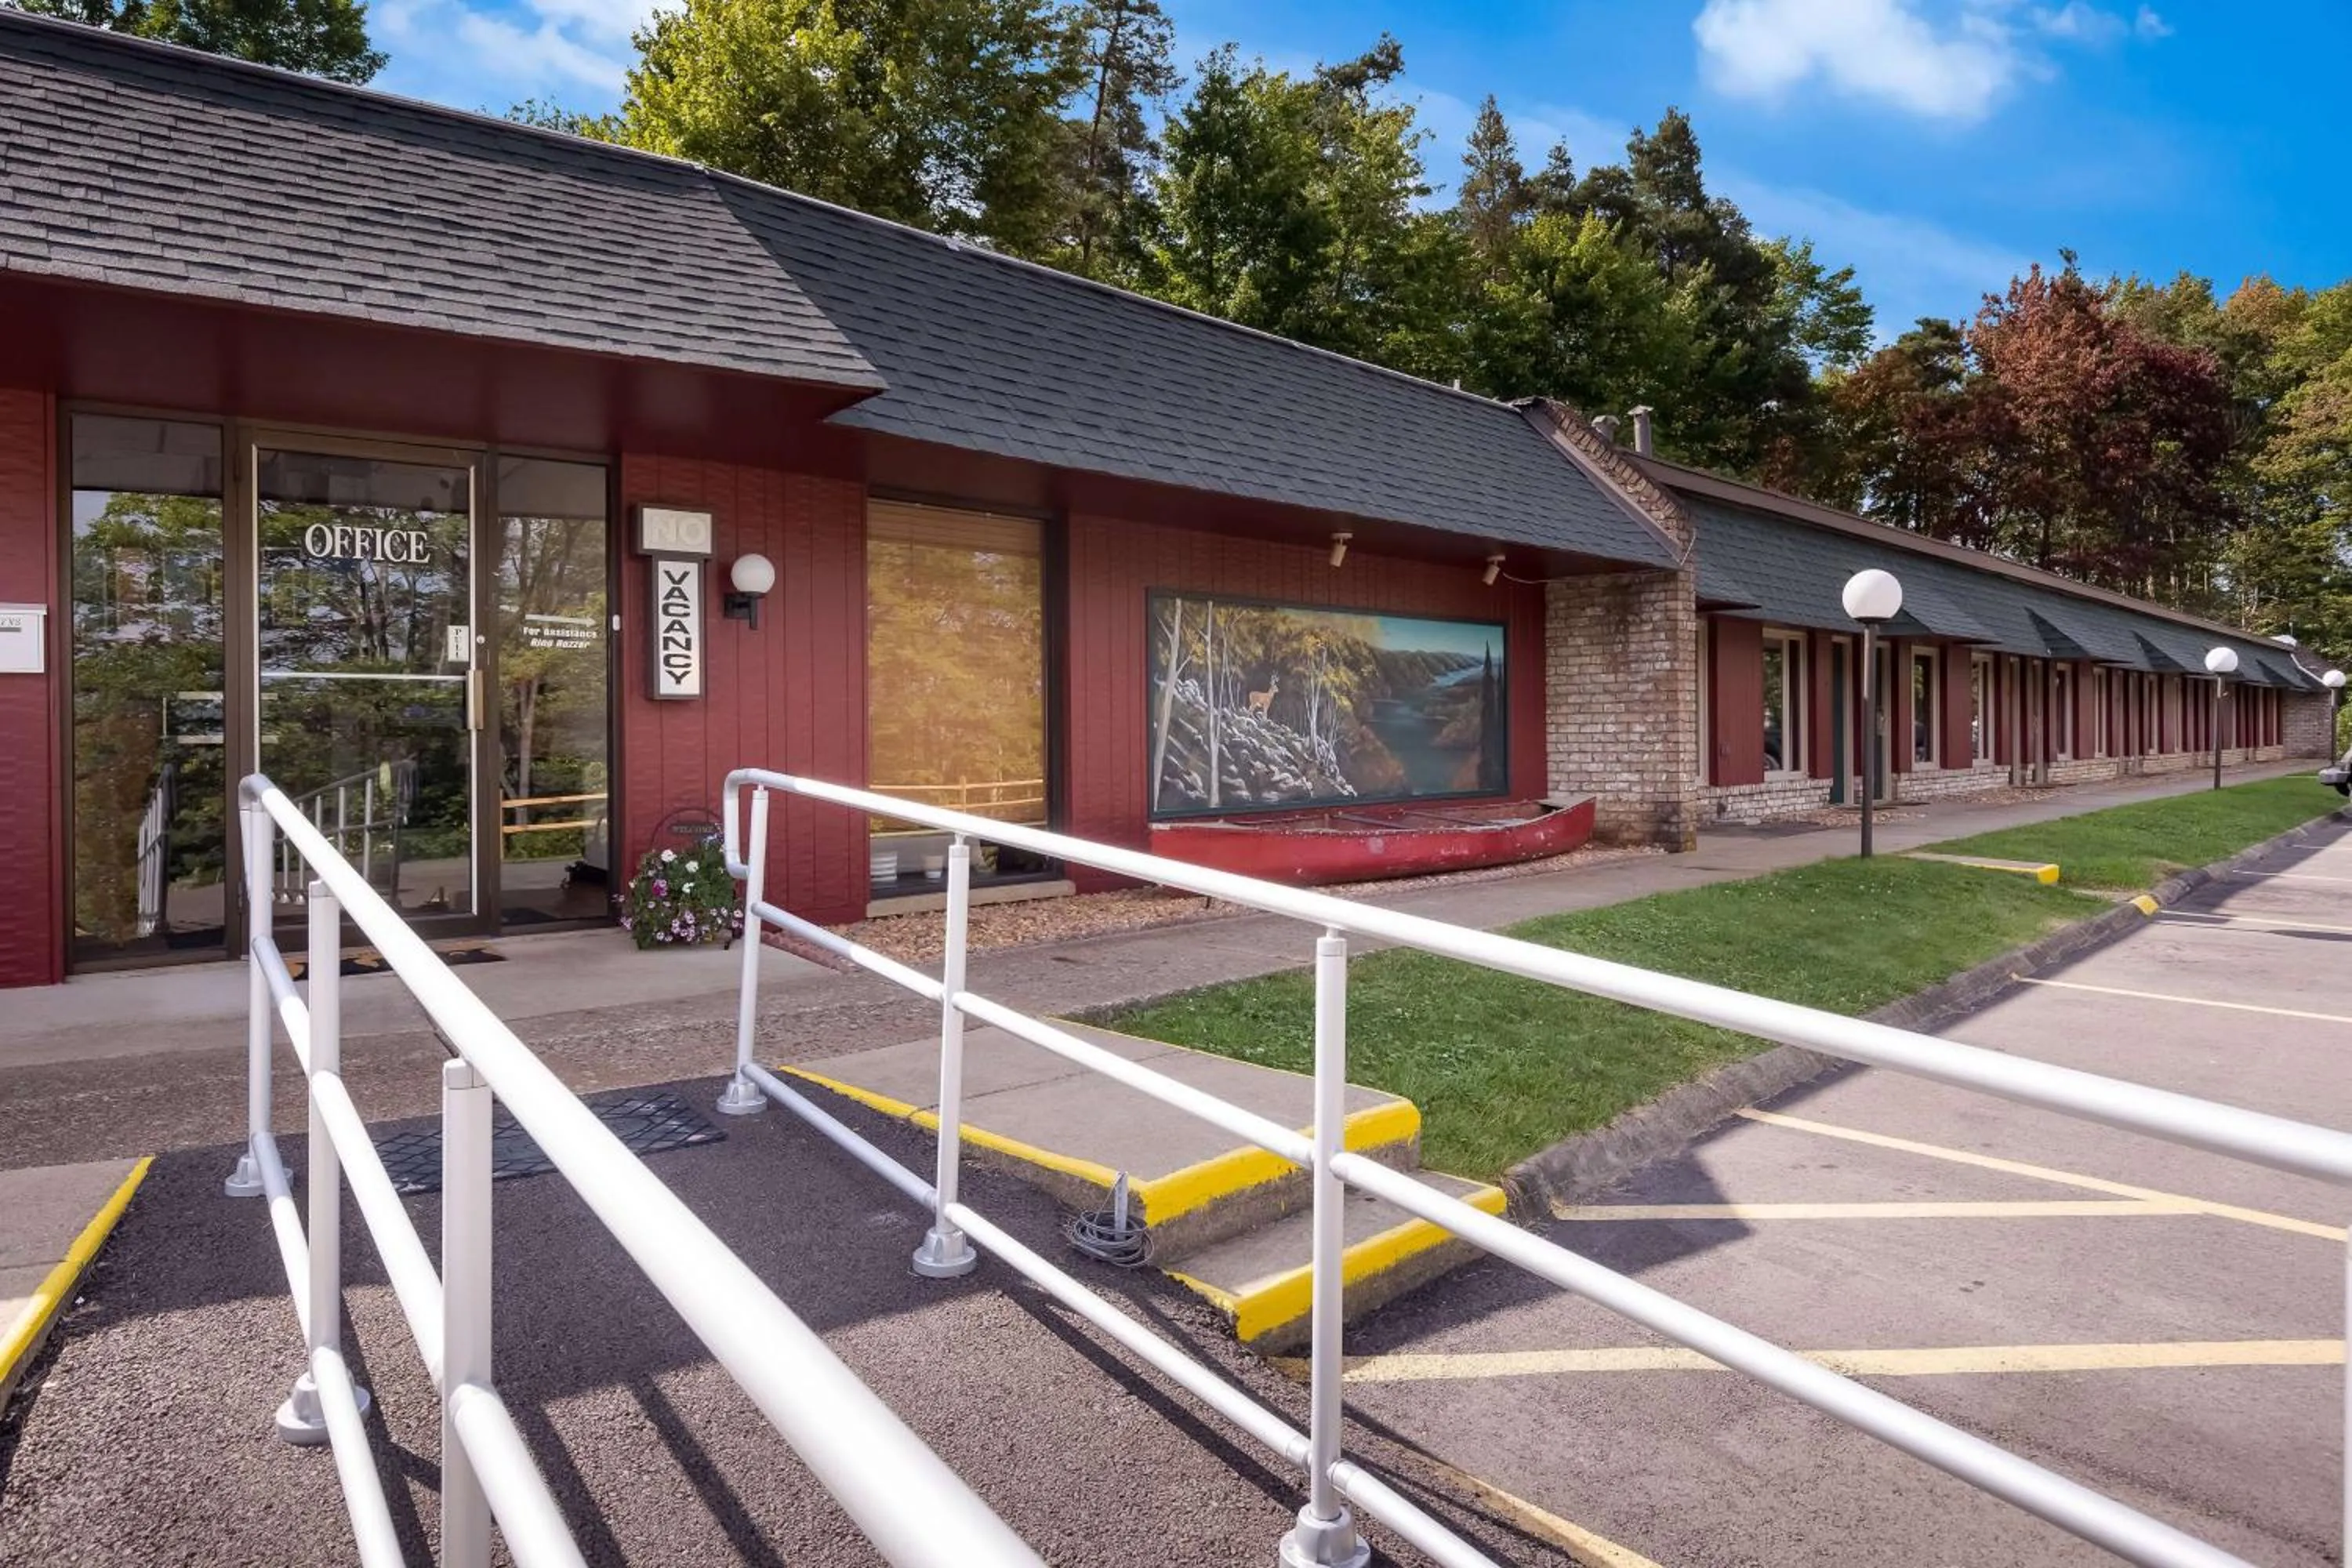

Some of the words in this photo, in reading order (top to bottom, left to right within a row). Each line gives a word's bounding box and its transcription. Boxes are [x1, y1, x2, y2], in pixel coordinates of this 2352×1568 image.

[305, 523, 430, 563] OFFICE
[652, 514, 706, 546] NO
[523, 627, 540, 636] For
[662, 570, 692, 685] VACANCY
